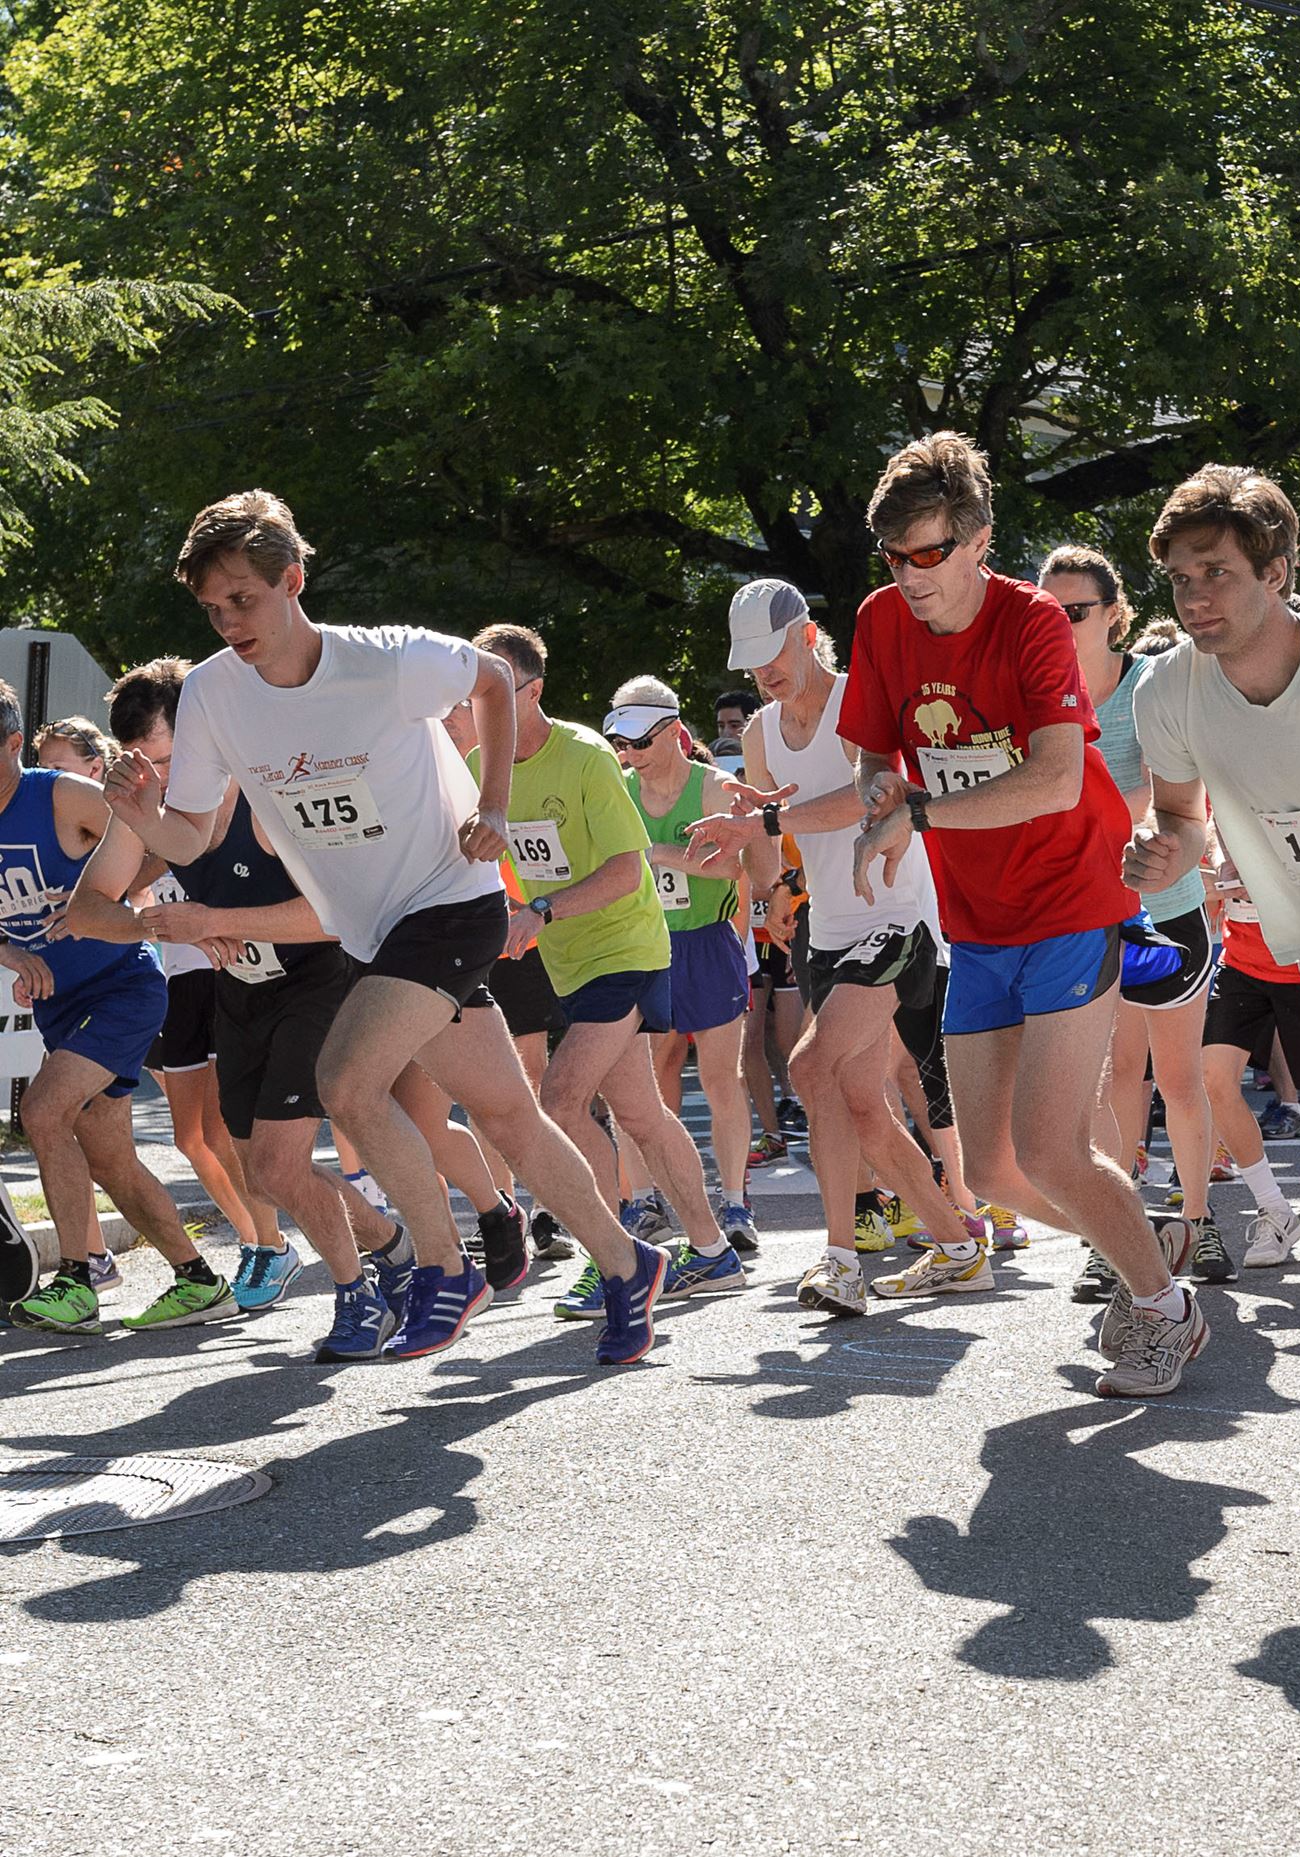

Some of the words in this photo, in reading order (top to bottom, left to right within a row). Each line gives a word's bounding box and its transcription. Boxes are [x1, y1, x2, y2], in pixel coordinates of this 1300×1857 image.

[932, 682, 957, 697] YEARS
[294, 795, 358, 828] 175
[513, 838, 552, 862] 169
[657, 872, 676, 893] 3
[10, 894, 47, 912] O'BRIE
